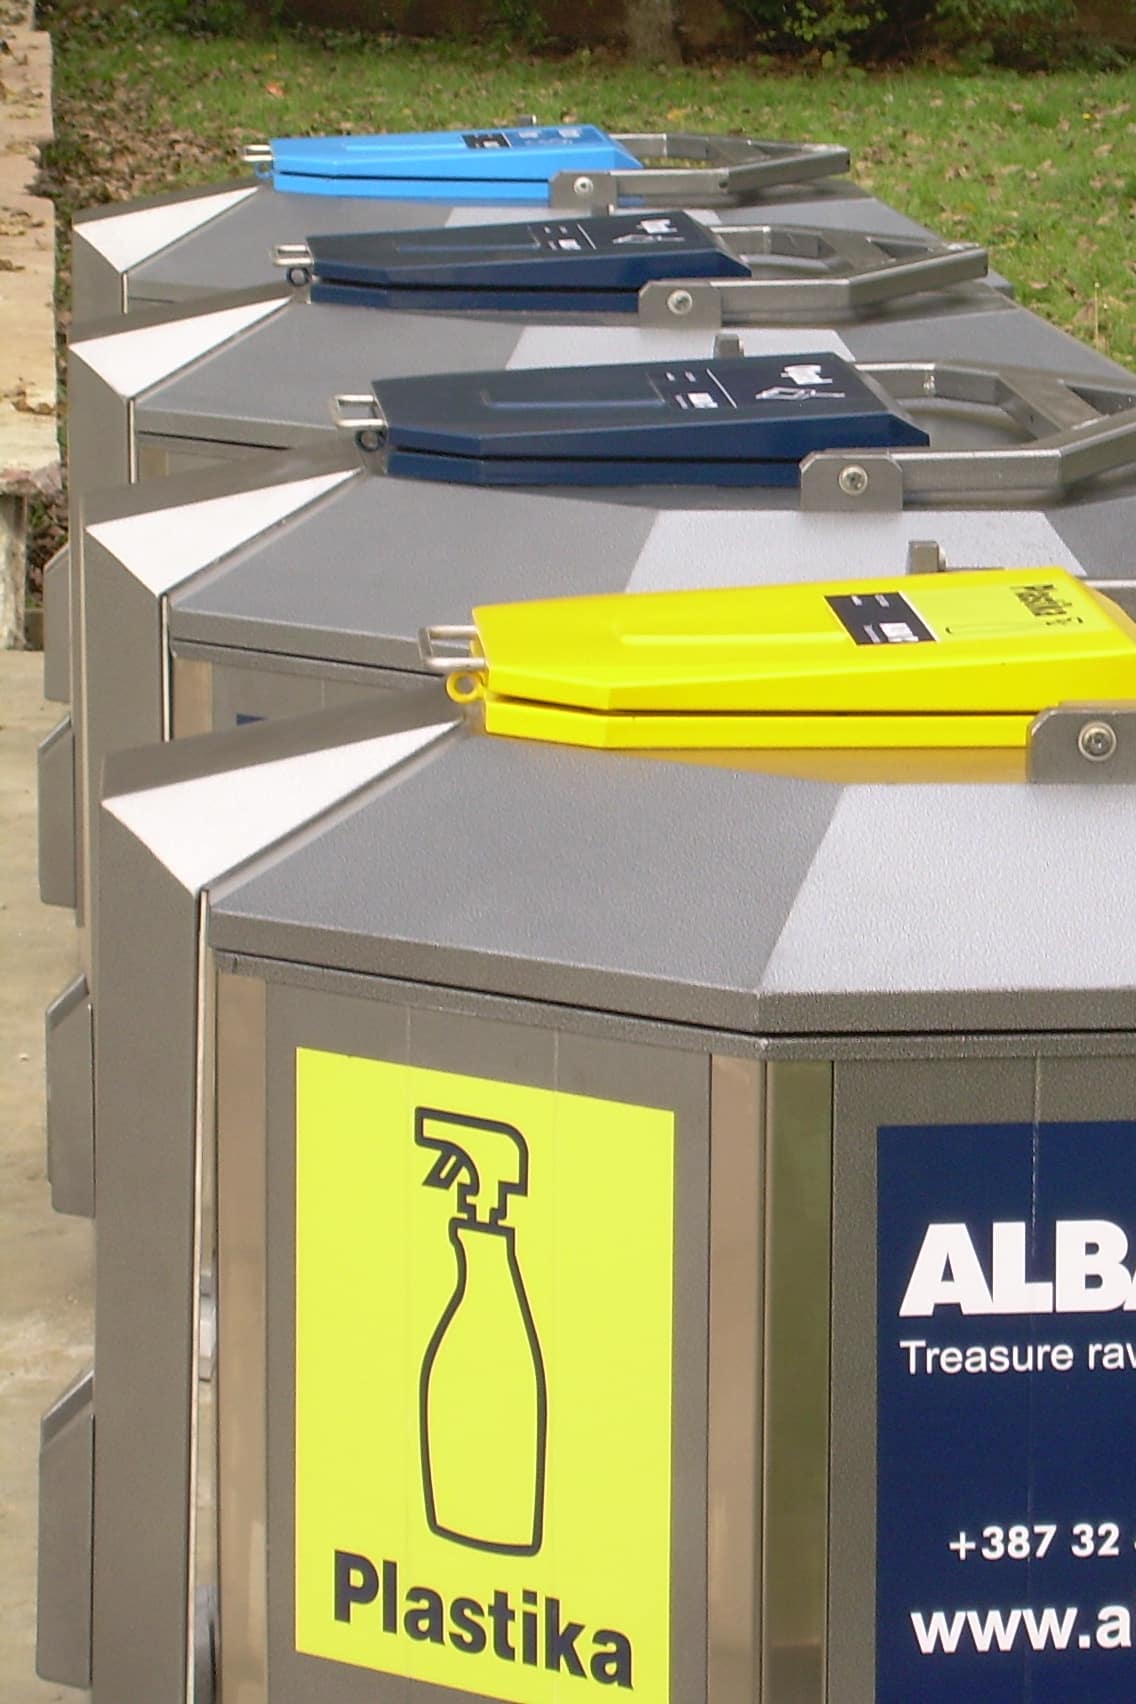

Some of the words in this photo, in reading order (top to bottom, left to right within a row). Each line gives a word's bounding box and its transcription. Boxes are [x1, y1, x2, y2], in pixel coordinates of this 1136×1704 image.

[900, 1340, 1073, 1374] Treasure
[950, 1525, 1056, 1560] +387
[1072, 1523, 1119, 1556] 32
[334, 1549, 634, 1690] Plastika
